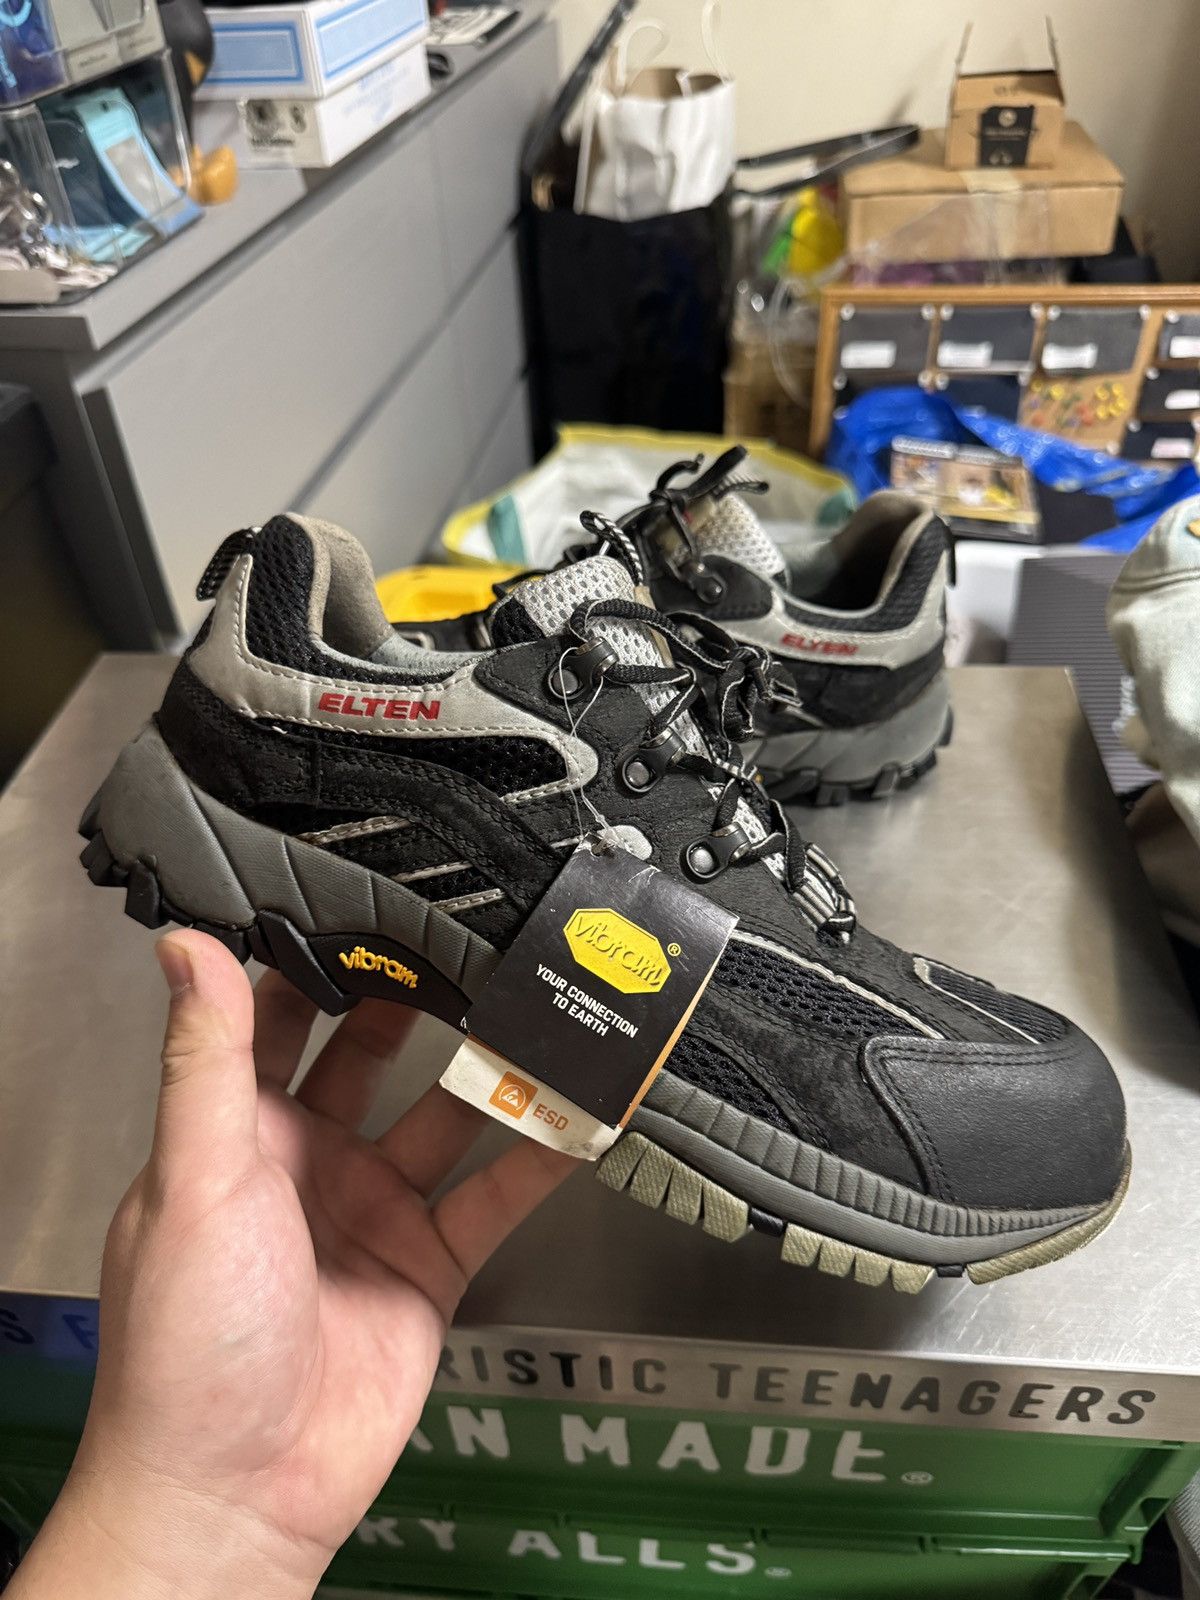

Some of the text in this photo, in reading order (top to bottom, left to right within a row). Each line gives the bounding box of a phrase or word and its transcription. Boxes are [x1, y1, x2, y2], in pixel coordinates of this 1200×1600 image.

[318, 692, 441, 720] ELTEN
[338, 945, 419, 989] vibram
[575, 916, 662, 986] vibram
[535, 963, 639, 1039] YOUR CONNECTION
[552, 992, 610, 1037] TO EARTH
[533, 1103, 569, 1131] ESD
[709, 1362, 1156, 1424] TEENAGERS
